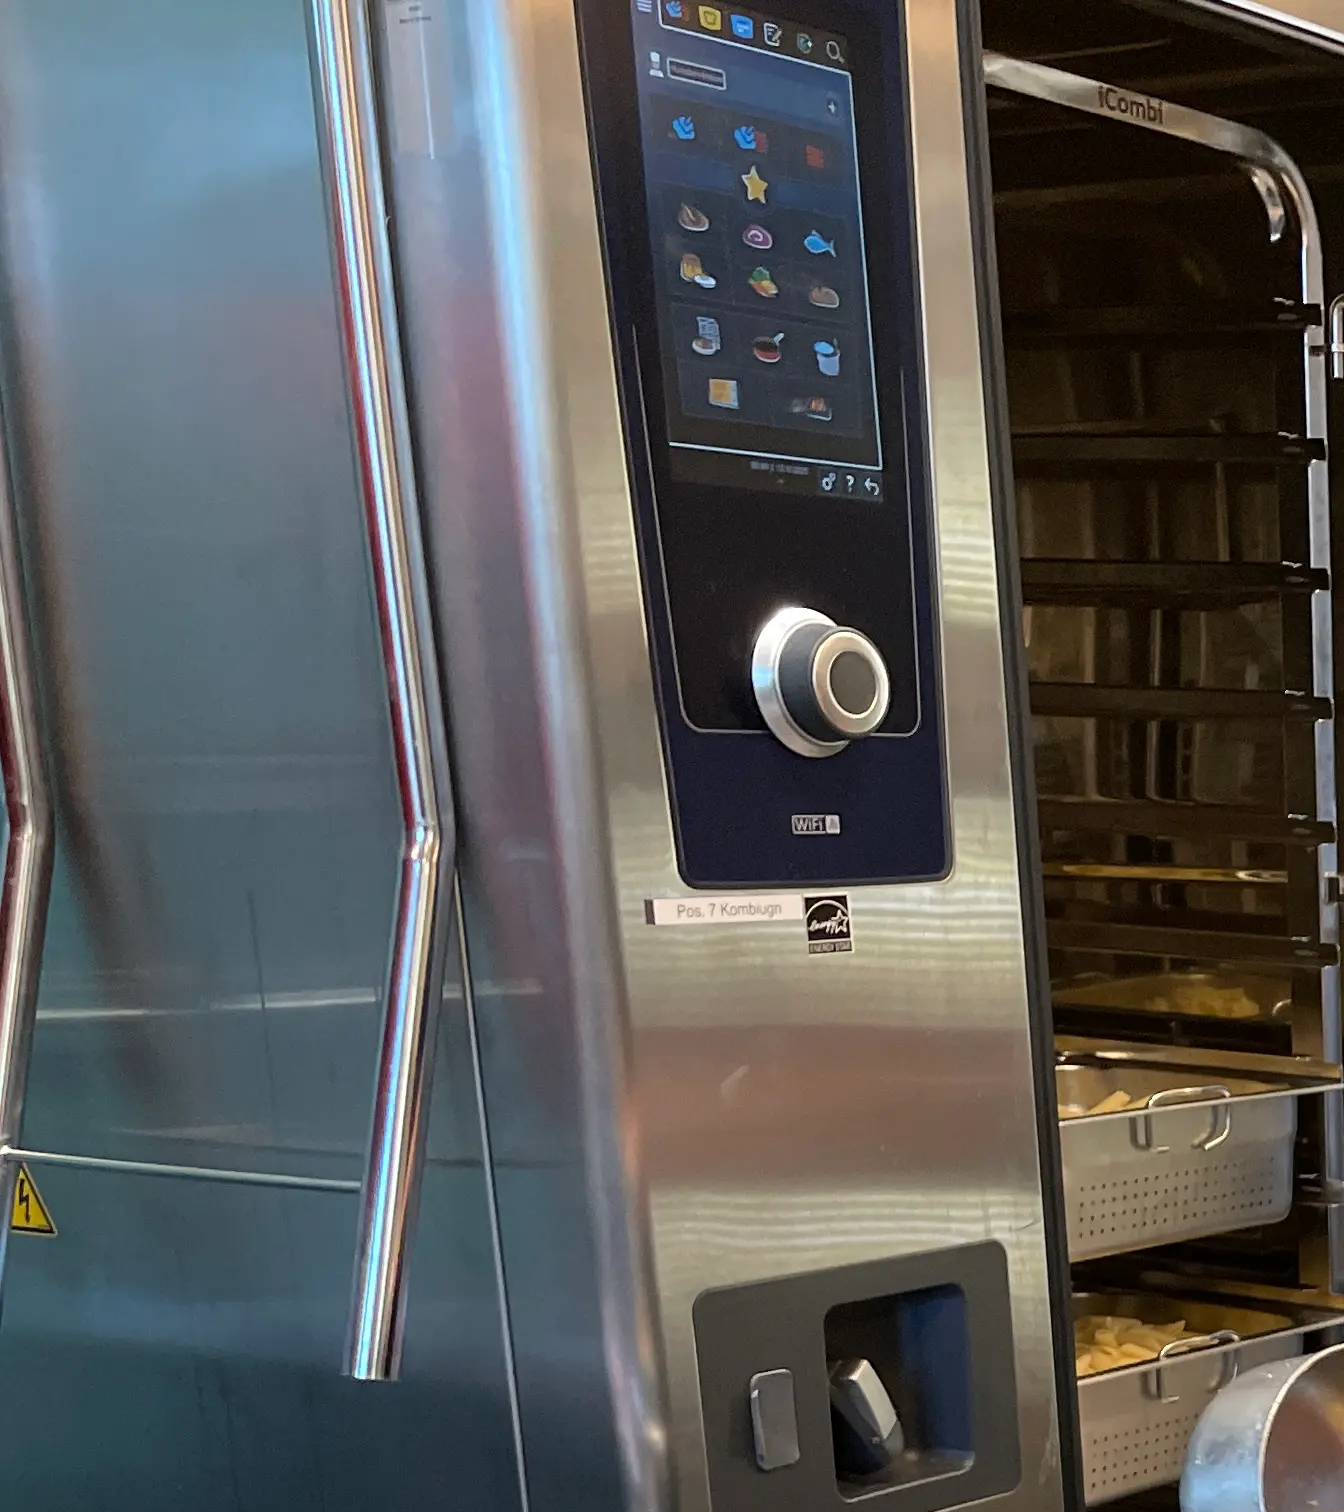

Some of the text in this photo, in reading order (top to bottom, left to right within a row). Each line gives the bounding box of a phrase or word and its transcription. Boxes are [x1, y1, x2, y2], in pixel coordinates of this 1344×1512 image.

[1097, 85, 1164, 124] iCombi
[676, 901, 782, 918] Pos. 7 Kombiugn
